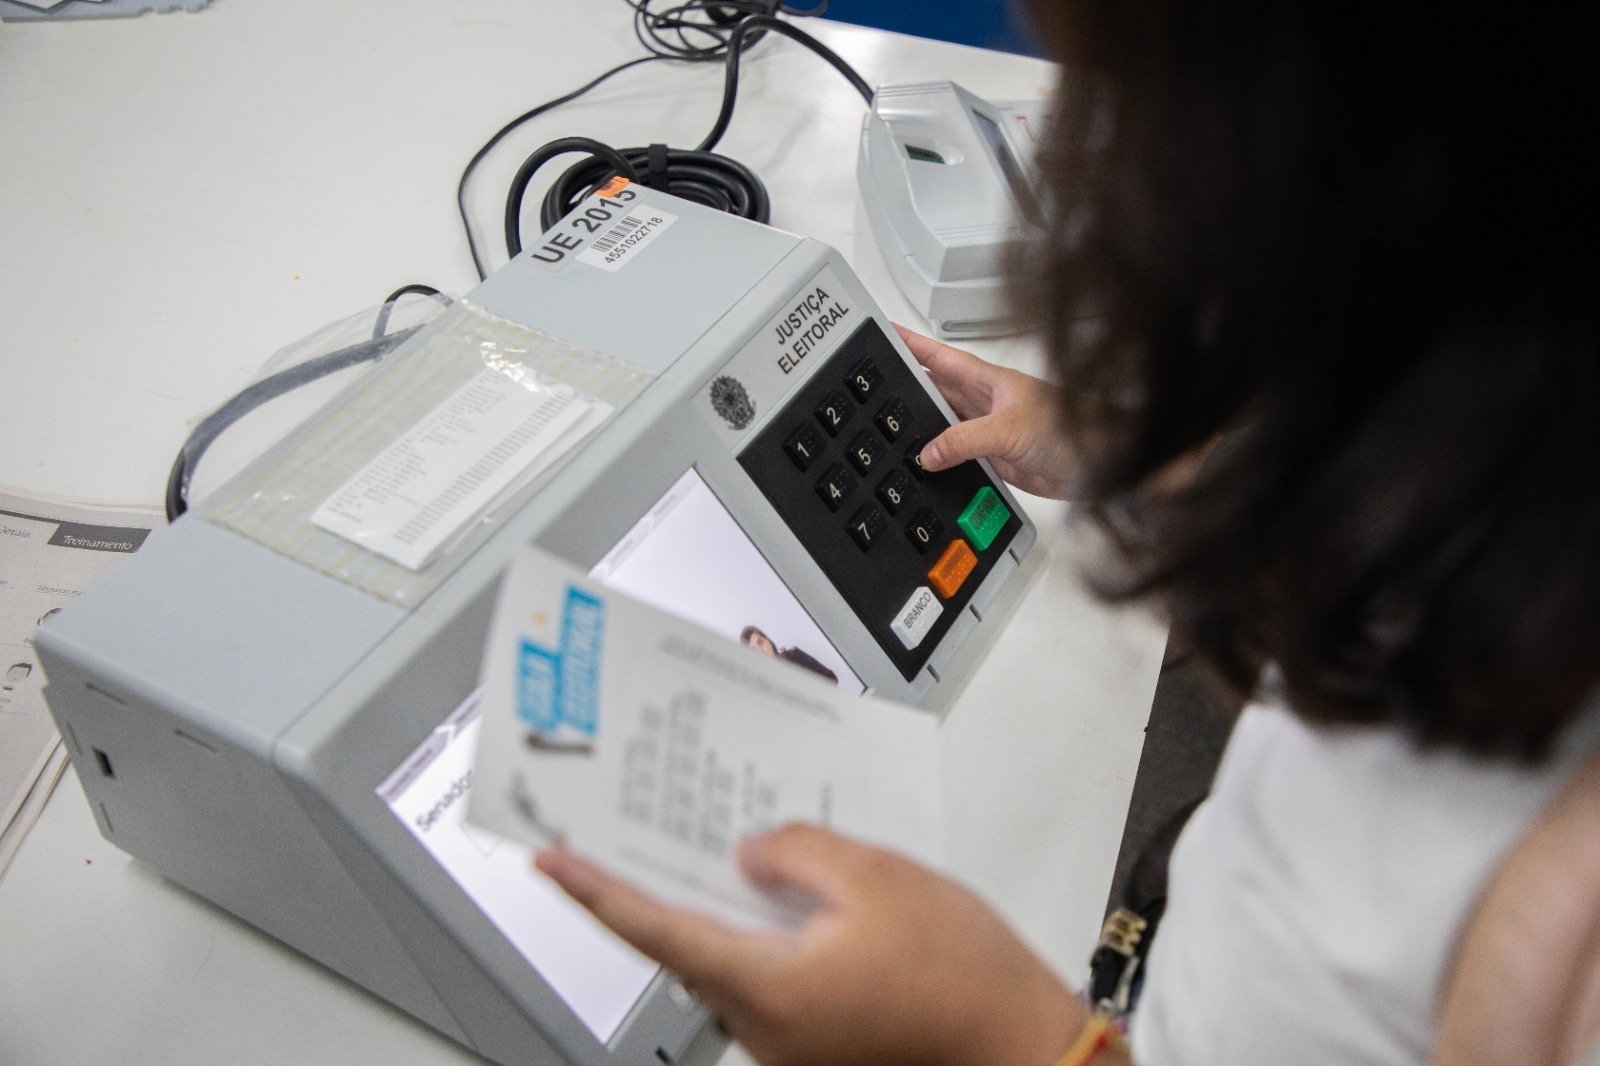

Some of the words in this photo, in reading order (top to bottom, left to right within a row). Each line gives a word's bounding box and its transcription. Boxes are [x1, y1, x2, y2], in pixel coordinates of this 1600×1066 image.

[531, 233, 583, 263] UE
[572, 189, 637, 233] 2015
[604, 217, 663, 264] 4551022718
[775, 287, 830, 345] JUSTIÇA
[777, 302, 849, 375] ELEITORAL
[856, 375, 870, 392] 3
[826, 407, 841, 425] 2
[886, 416, 900, 432] 6
[797, 442, 810, 457] 1
[858, 448, 871, 465] 5
[829, 482, 842, 498] 4
[888, 487, 901, 504] 8
[858, 522, 871, 540] 7
[916, 526, 930, 542] 0
[63, 535, 133, 550] Treinamento
[903, 591, 932, 629] BRANCO
